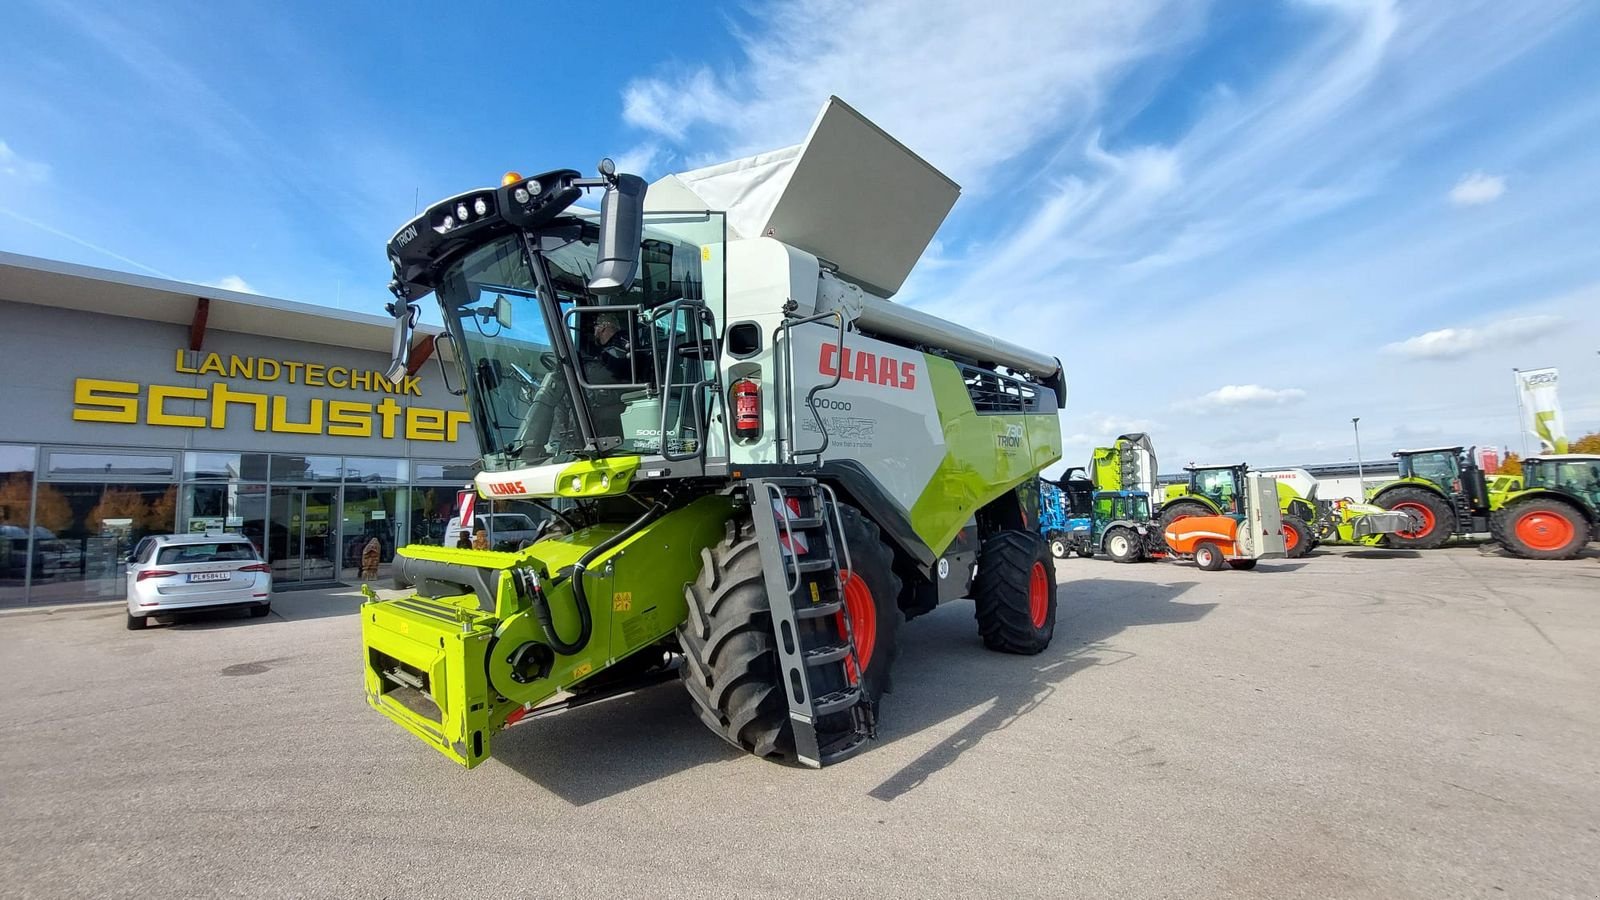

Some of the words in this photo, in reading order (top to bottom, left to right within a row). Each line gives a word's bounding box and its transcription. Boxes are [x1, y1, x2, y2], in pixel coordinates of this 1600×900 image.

[396, 224, 418, 248] TRION
[174, 348, 423, 397] LANDTECHNIK
[819, 342, 916, 391] CLAAS
[997, 434, 1020, 448] TRION
[489, 481, 527, 495] CLAAS
